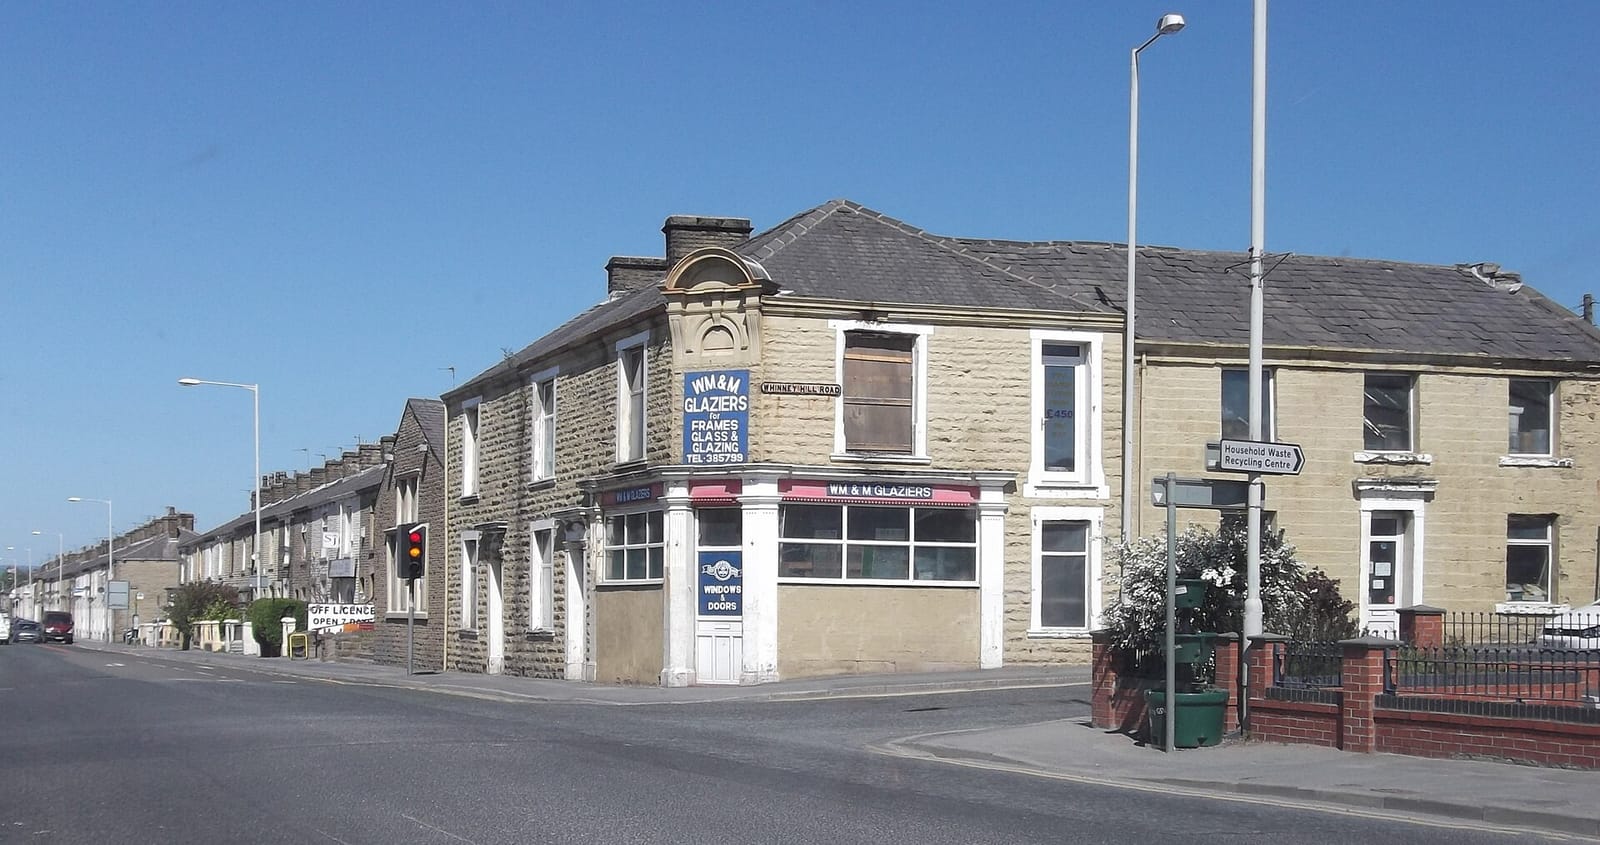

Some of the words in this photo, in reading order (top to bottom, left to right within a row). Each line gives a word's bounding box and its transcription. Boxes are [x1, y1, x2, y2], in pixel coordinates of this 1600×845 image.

[763, 384, 797, 393] WHINNEY
[800, 385, 817, 393] HILL
[820, 386, 840, 394] ROAD
[684, 396, 748, 413] GLAZIERS
[709, 412, 720, 420] for
[691, 420, 739, 431] FRAMES
[691, 431, 729, 442] GLASS
[731, 431, 739, 441] &
[692, 442, 739, 453] GLAZING
[1225, 444, 1266, 456] Household
[1268, 447, 1292, 458] Waste
[1225, 455, 1263, 469] Recycling
[1264, 458, 1291, 469] Centre
[829, 483, 848, 495] WM
[850, 484, 860, 495] &
[862, 485, 873, 496] M
[874, 485, 931, 497] GLAZIERS
[703, 585, 742, 594] WINDOWS
[311, 606, 330, 615] OFF
[333, 606, 376, 615] LICENCE
[707, 602, 737, 611] DOORS
[313, 617, 338, 625] OPEN
